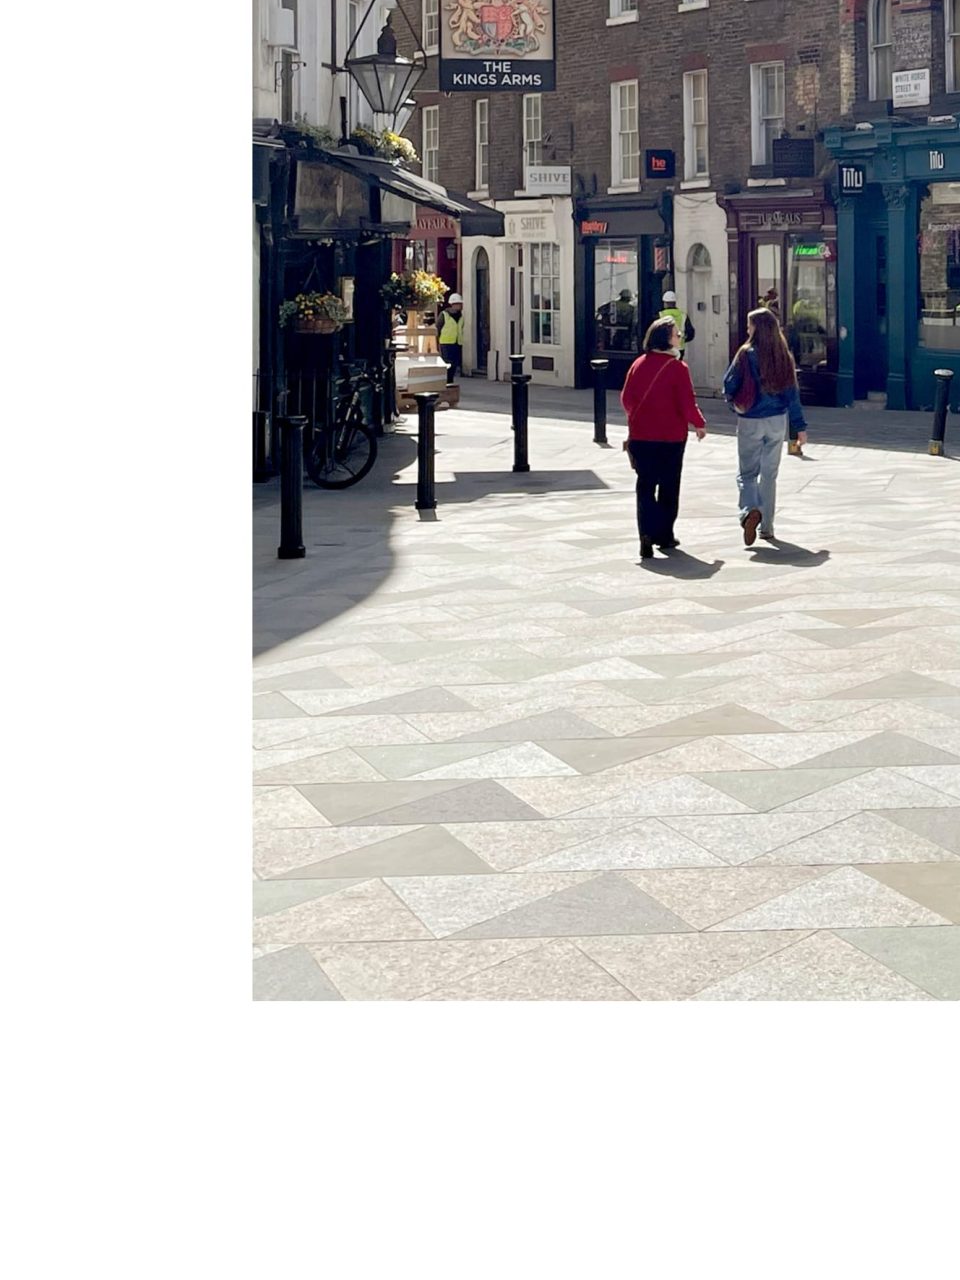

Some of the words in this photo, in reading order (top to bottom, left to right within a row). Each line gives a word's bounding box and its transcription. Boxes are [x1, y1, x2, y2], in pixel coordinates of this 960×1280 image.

[483, 61, 511, 73] THE
[453, 73, 497, 85] KINGS
[501, 74, 542, 86] ARMS
[652, 156, 667, 168] he
[529, 172, 569, 183] SHIVE
[520, 216, 547, 231] SHIVE
